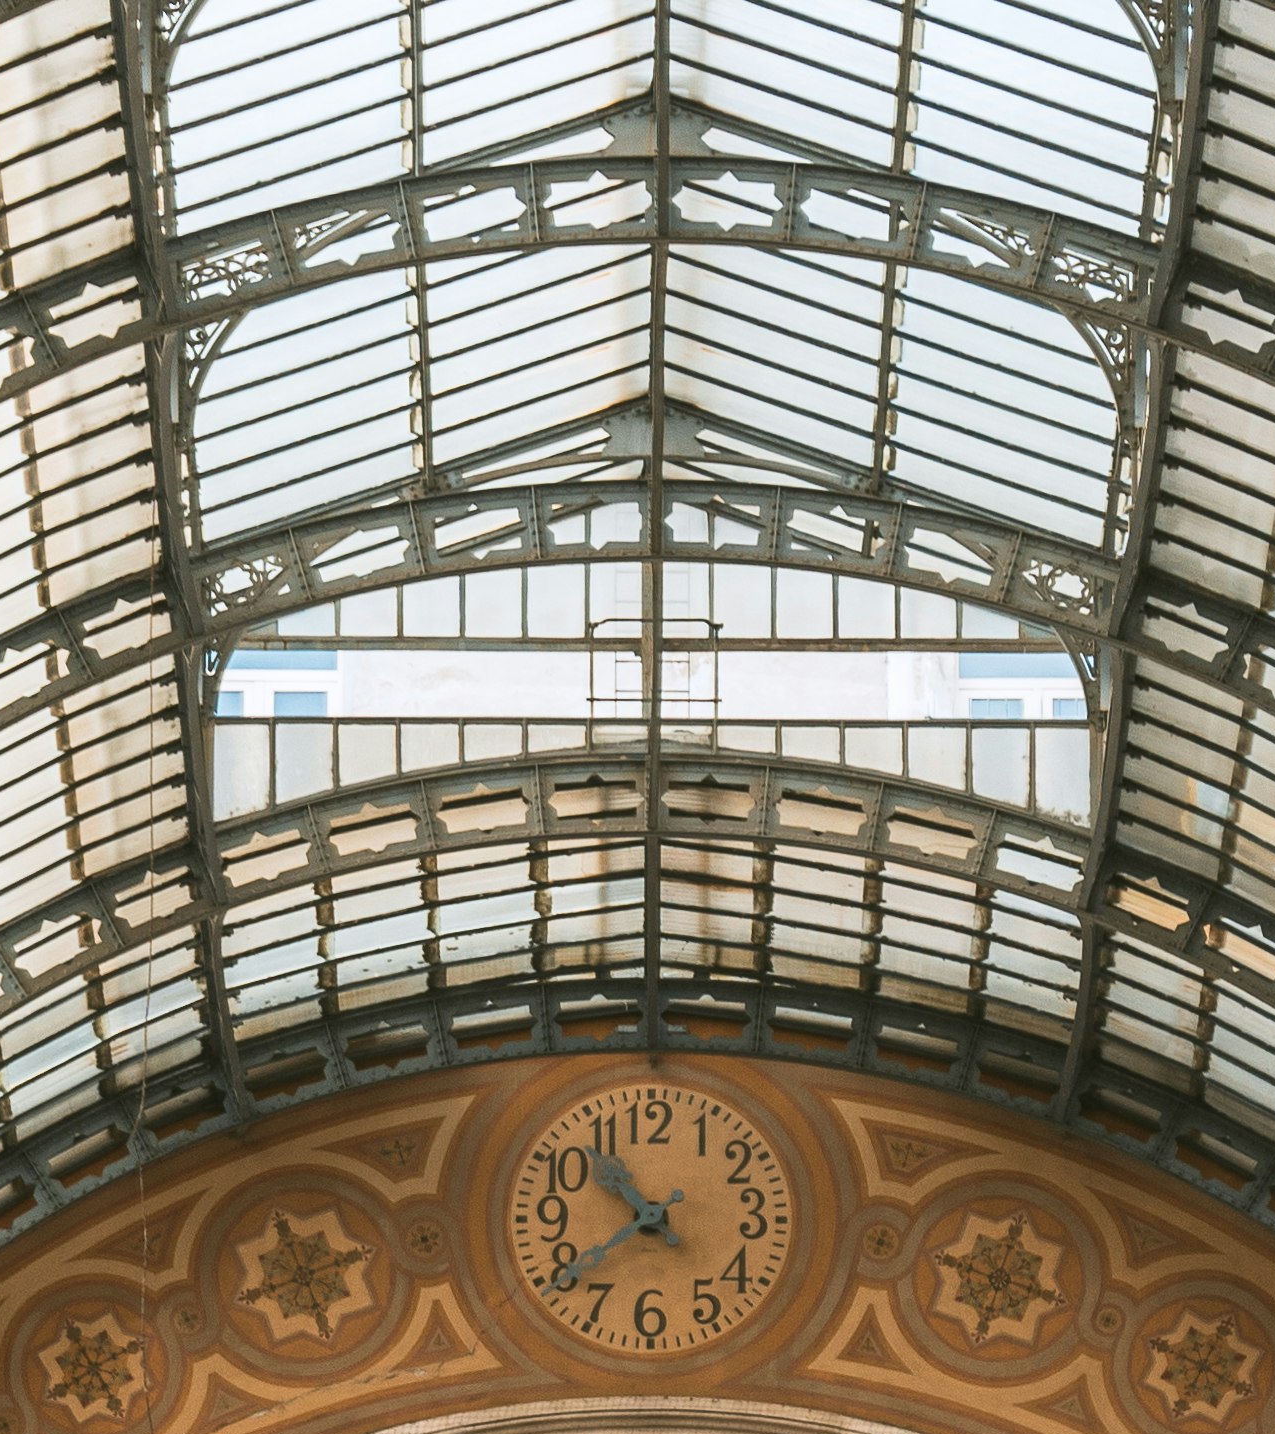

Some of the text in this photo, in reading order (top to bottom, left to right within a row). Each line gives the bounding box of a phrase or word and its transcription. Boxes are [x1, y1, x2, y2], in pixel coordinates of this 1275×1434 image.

[589, 1111, 617, 1156] 11
[626, 1100, 673, 1145] 12
[693, 1111, 708, 1157] 1
[544, 1146, 589, 1194] 10
[725, 1139, 753, 1185] 2
[536, 1194, 569, 1243] 9
[739, 1187, 768, 1240] 3
[550, 1241, 579, 1293] 8
[720, 1245, 753, 1294] 4
[586, 1282, 615, 1324] 7
[633, 1289, 668, 1338] 6
[692, 1278, 722, 1325] 5
